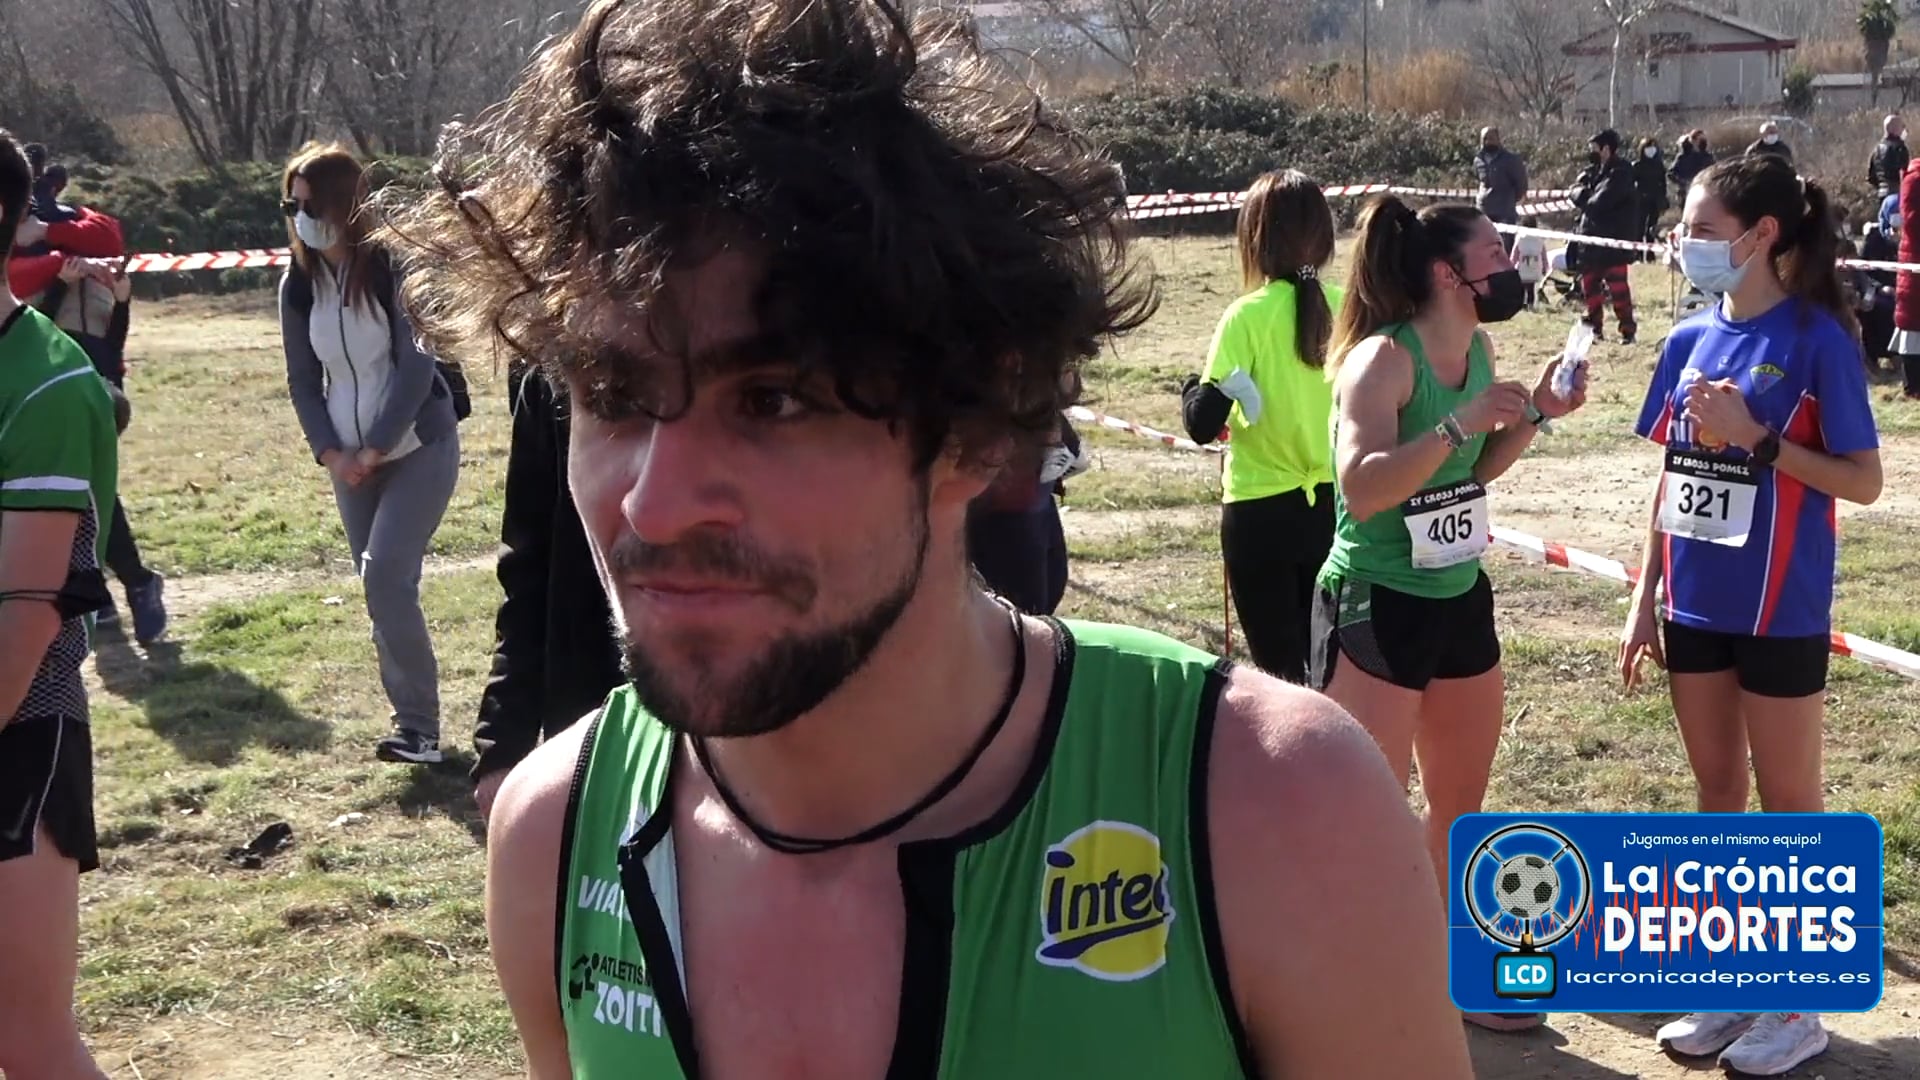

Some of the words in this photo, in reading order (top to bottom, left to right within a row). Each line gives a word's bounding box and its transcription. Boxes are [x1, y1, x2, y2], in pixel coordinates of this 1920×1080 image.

[1683, 457, 1710, 470] CROSS
[1424, 490, 1453, 504] CROSS
[1678, 482, 1731, 521] 321
[1427, 507, 1472, 546] 405
